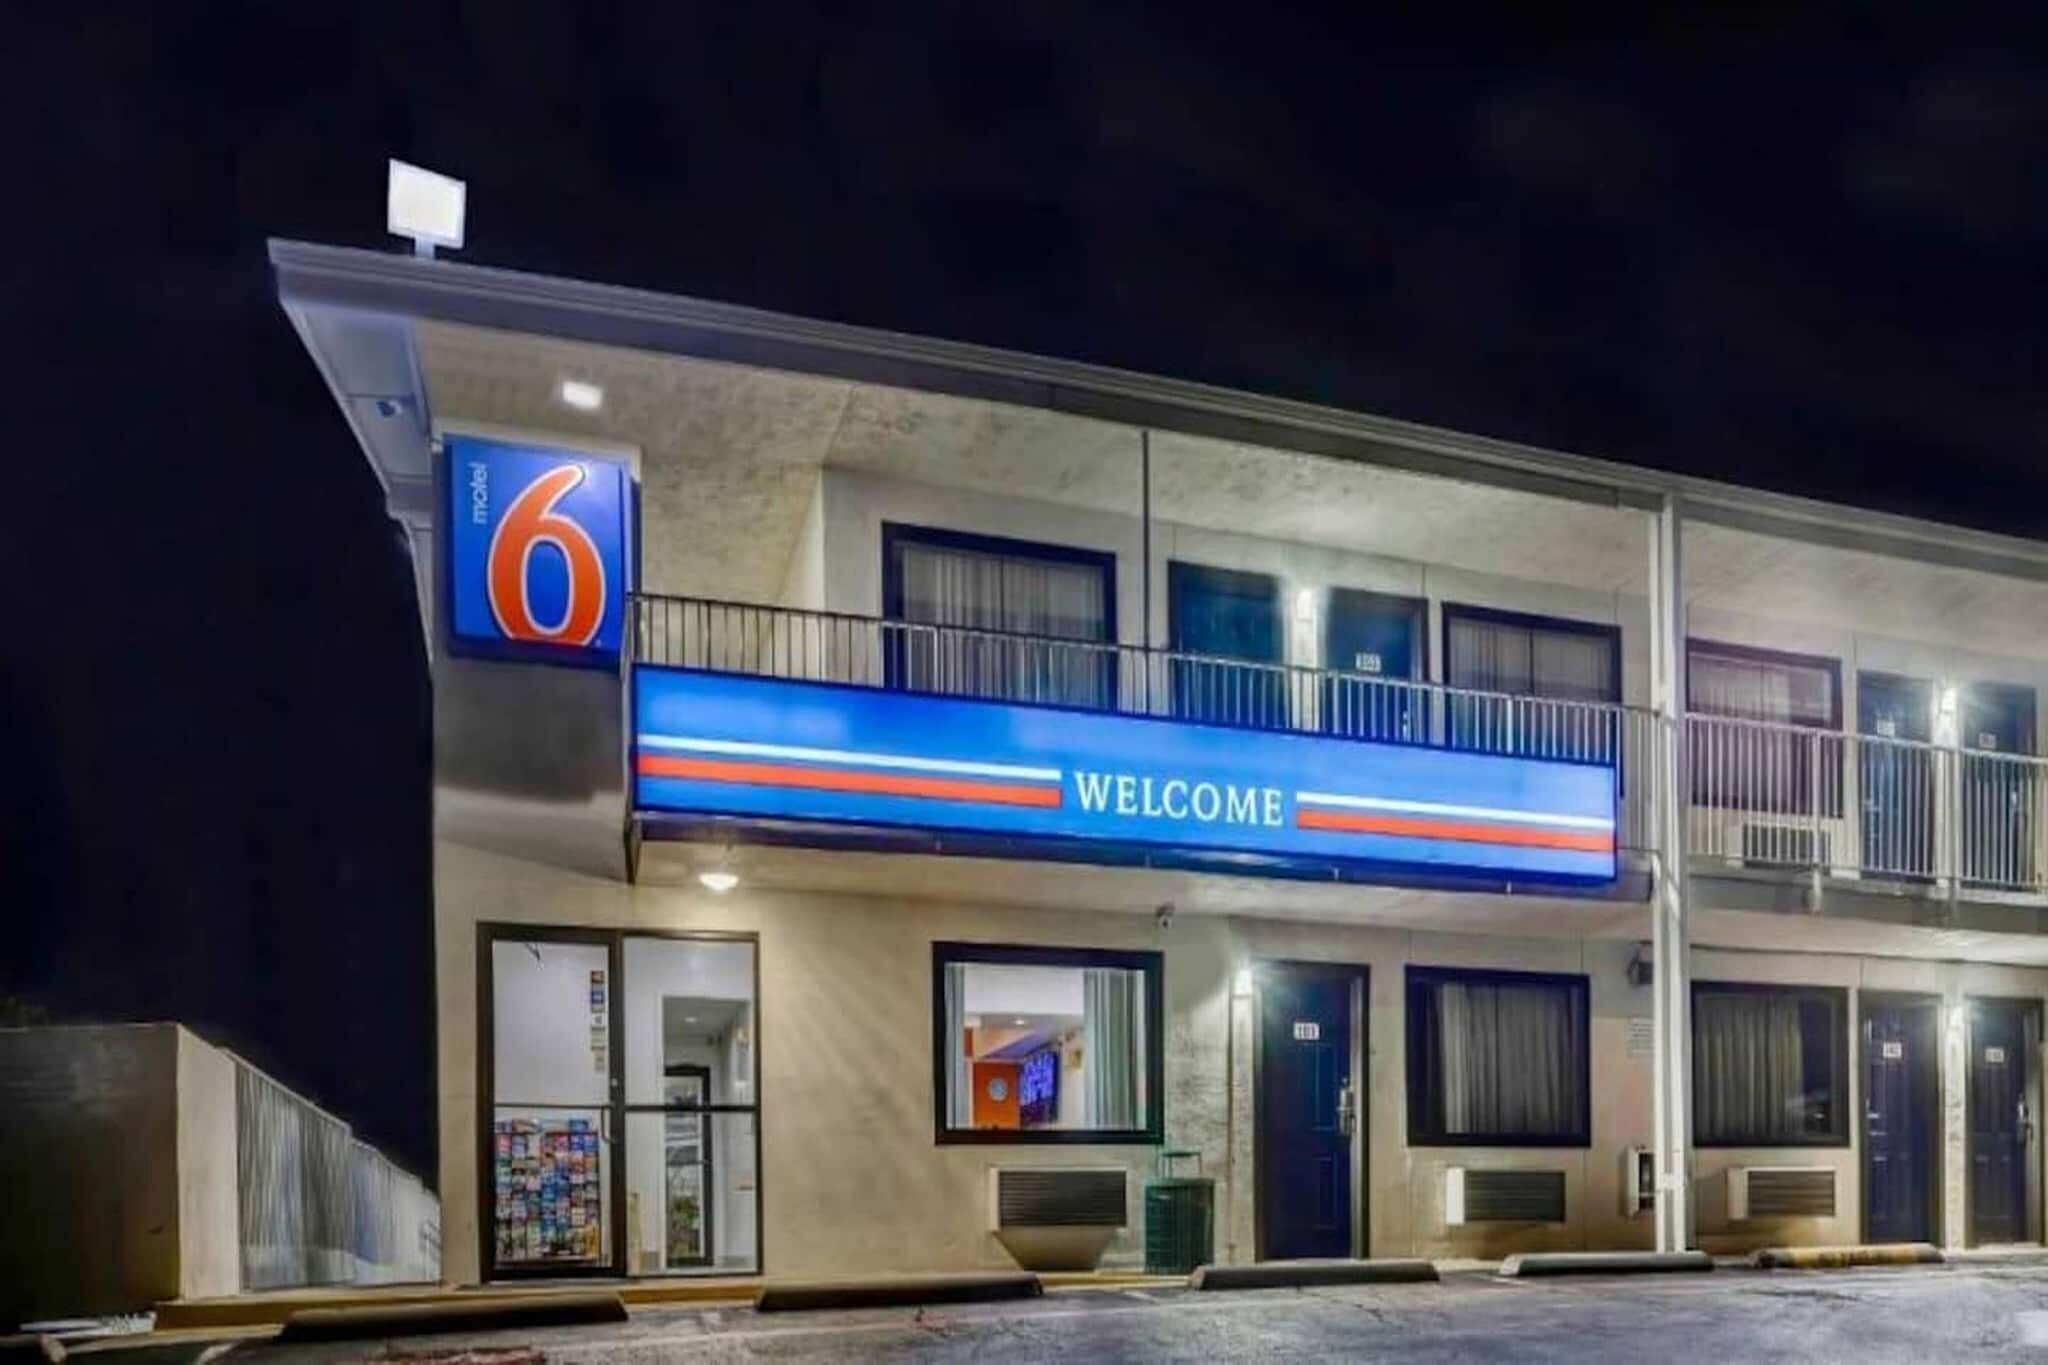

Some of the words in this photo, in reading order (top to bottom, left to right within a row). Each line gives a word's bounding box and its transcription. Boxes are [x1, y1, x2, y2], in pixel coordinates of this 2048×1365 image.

[467, 462, 488, 525] motel
[486, 463, 607, 648] 6
[1073, 770, 1284, 827] WELCOME
